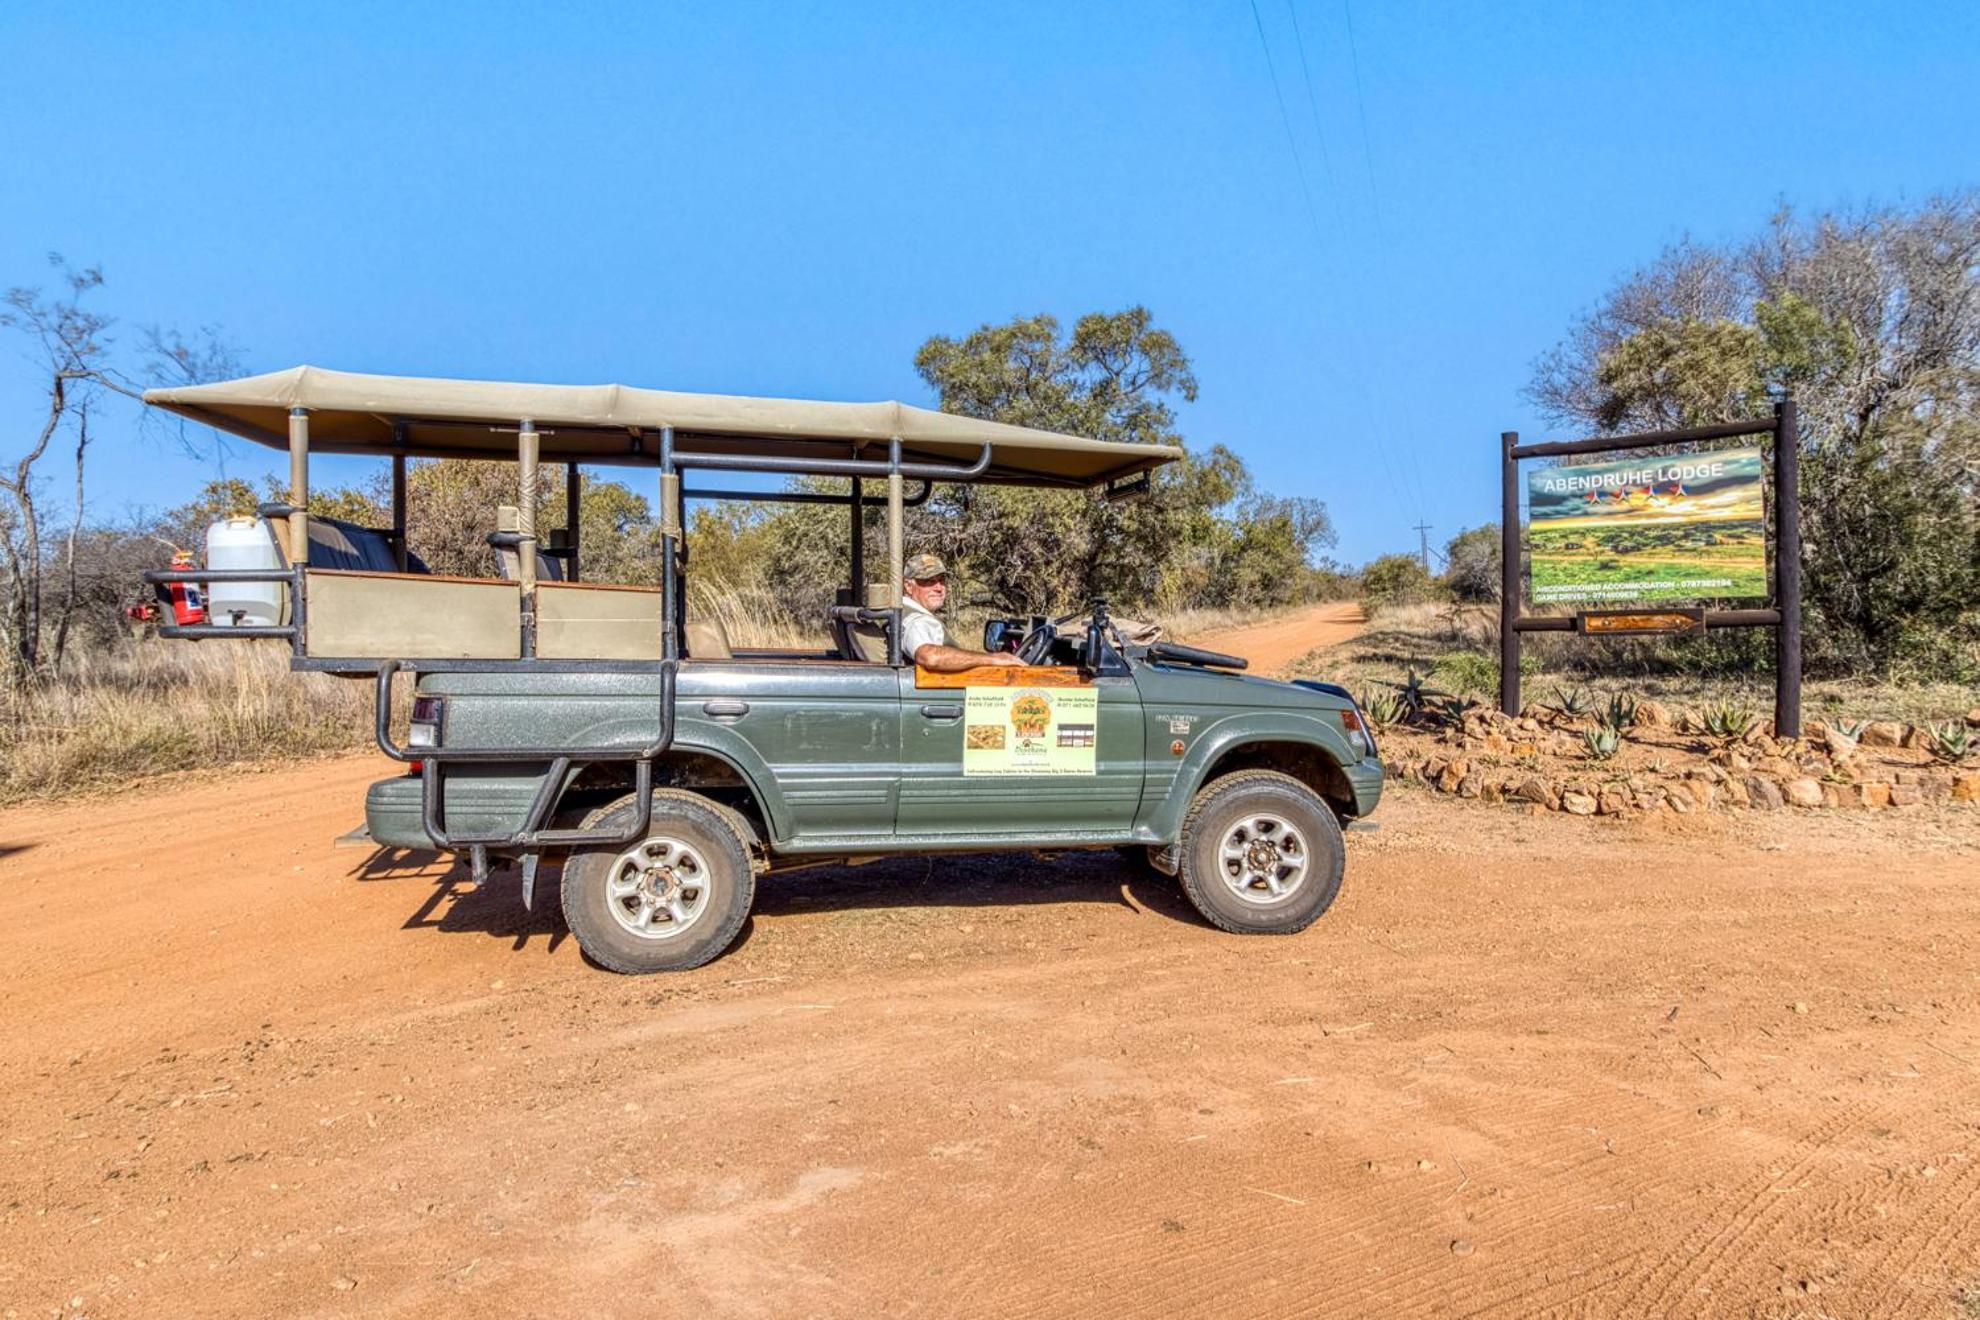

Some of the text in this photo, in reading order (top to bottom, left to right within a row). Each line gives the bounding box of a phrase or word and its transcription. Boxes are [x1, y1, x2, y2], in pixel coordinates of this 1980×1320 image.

[1544, 462, 1724, 493] ABENDRUHE LODGE
[1602, 580, 1676, 591] ACCOMMODATION
[1535, 593, 1558, 601] GAME
